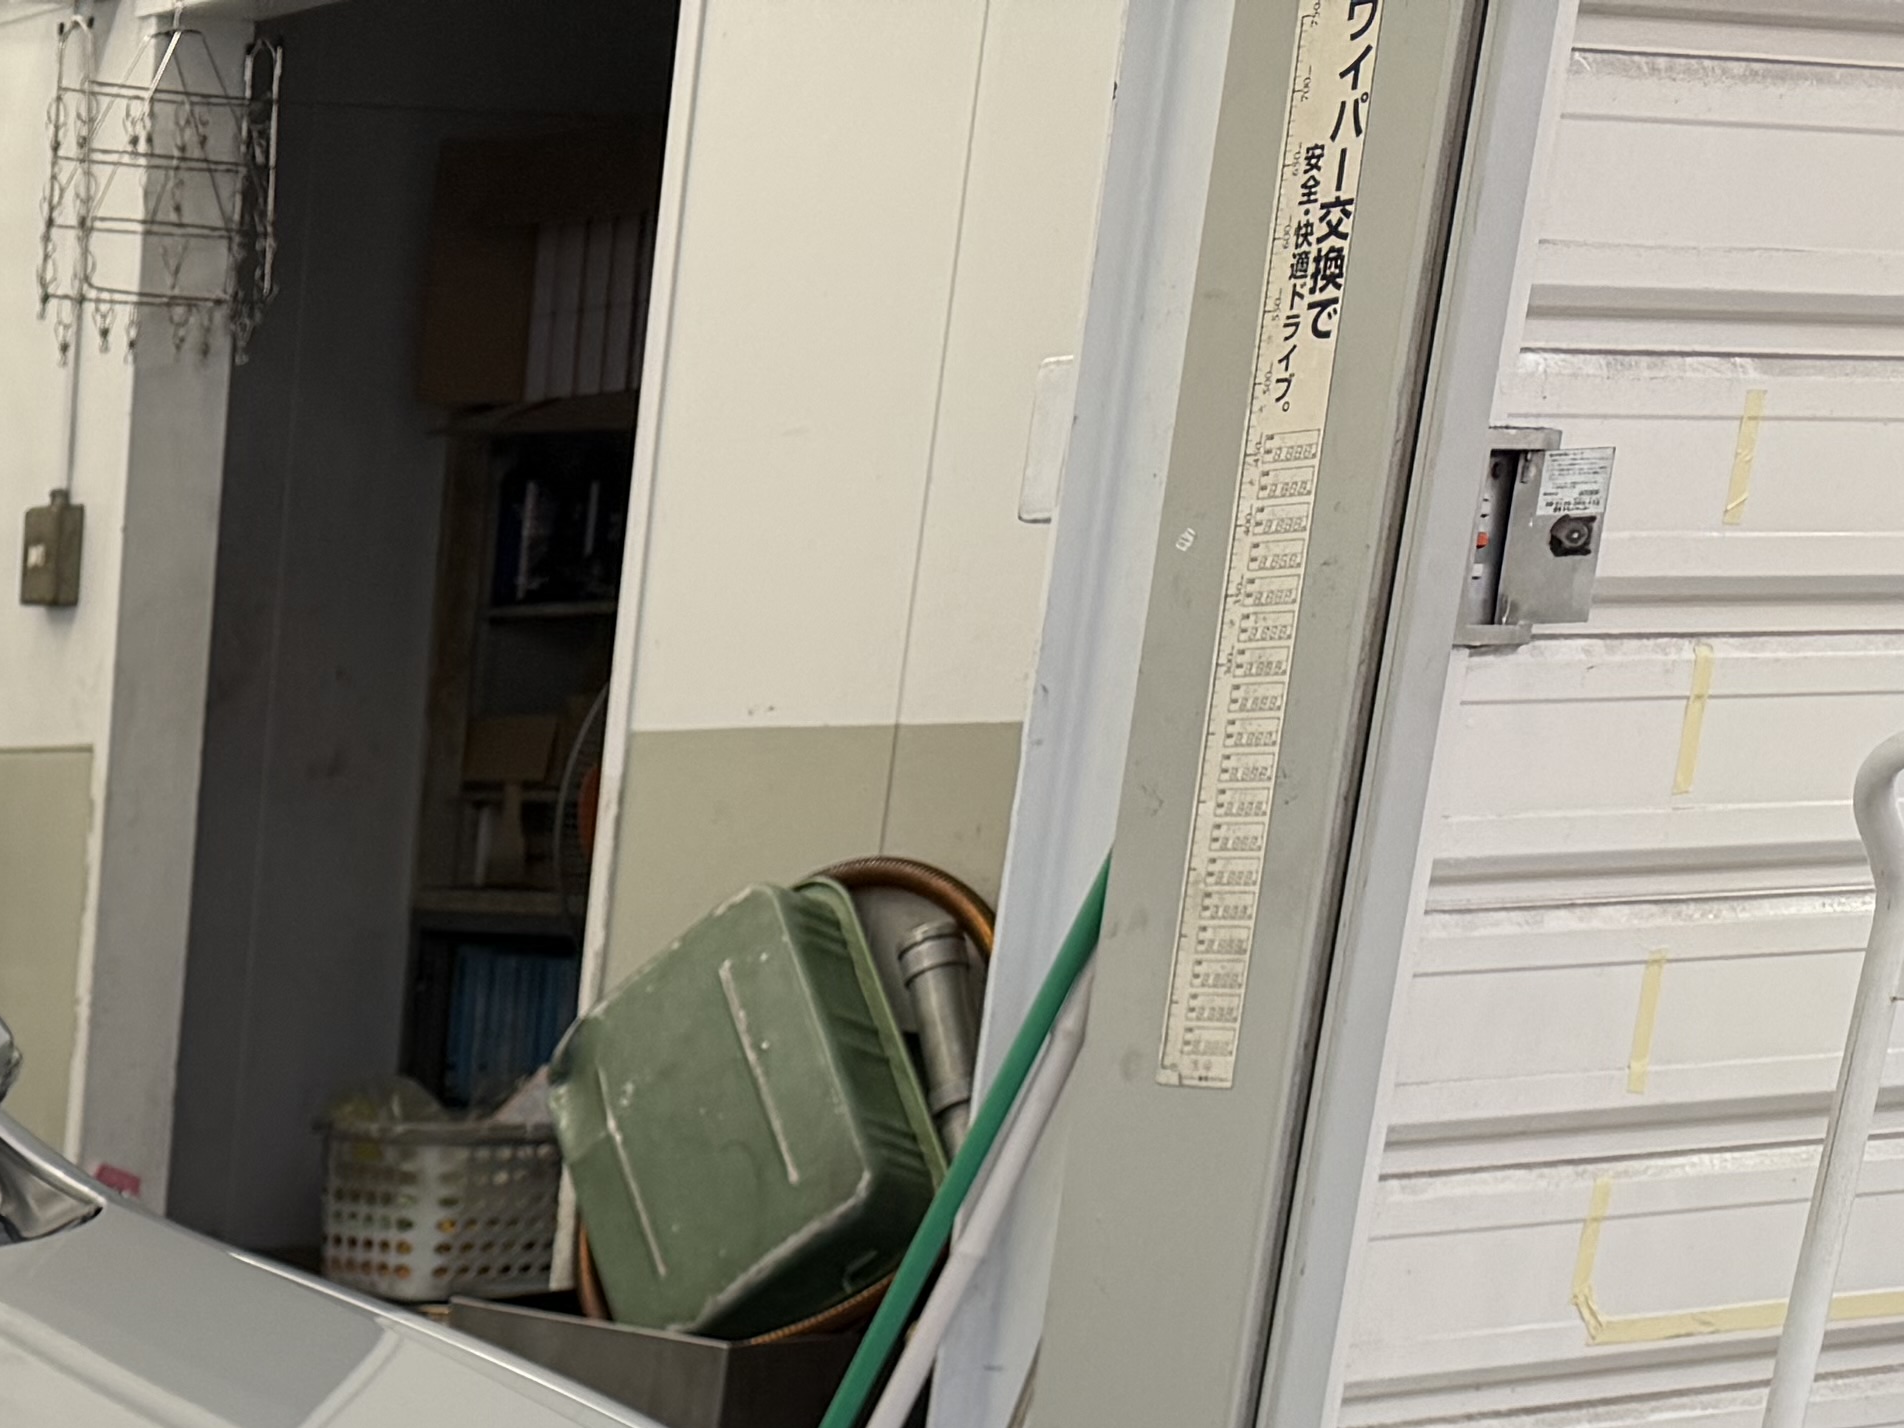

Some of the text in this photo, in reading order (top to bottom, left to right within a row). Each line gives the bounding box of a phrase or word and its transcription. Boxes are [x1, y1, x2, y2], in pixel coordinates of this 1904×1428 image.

[1274, 143, 1325, 412] 安全・快適ドライブ。
[1307, 0, 1379, 339] ワイパー交換で
